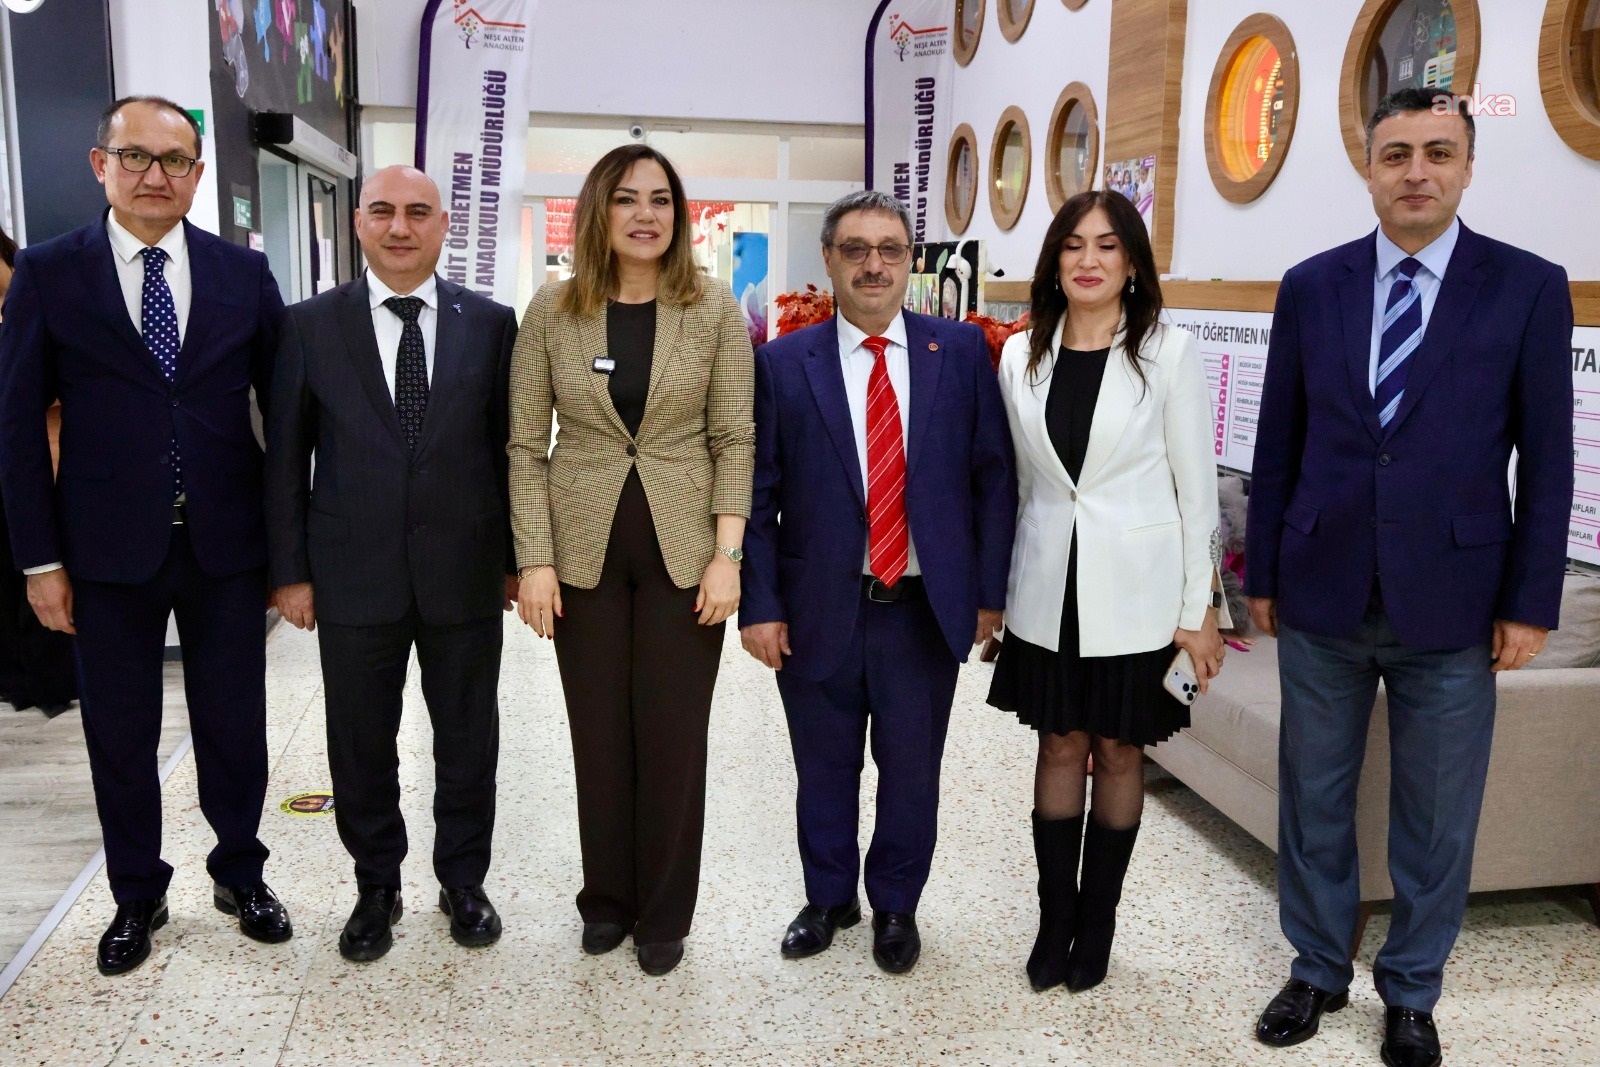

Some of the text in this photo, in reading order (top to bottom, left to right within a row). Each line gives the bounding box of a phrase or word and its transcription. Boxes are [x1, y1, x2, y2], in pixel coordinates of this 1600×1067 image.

[483, 42, 524, 52] ANAOKULU
[484, 33, 524, 43] NEŞE ALTEN
[478, 70, 507, 188] MÜDÜRLÜĞÜ
[914, 76, 936, 243] KULU MÜDÜRLÜĞÜ
[444, 152, 473, 290] HİT ÖĞRETMEN
[475, 191, 500, 287] ANAOKULU
[1203, 321, 1258, 344] ÖĞRETMEN
[1572, 348, 1600, 373] TA
[1571, 503, 1597, 515] NIFLARI
